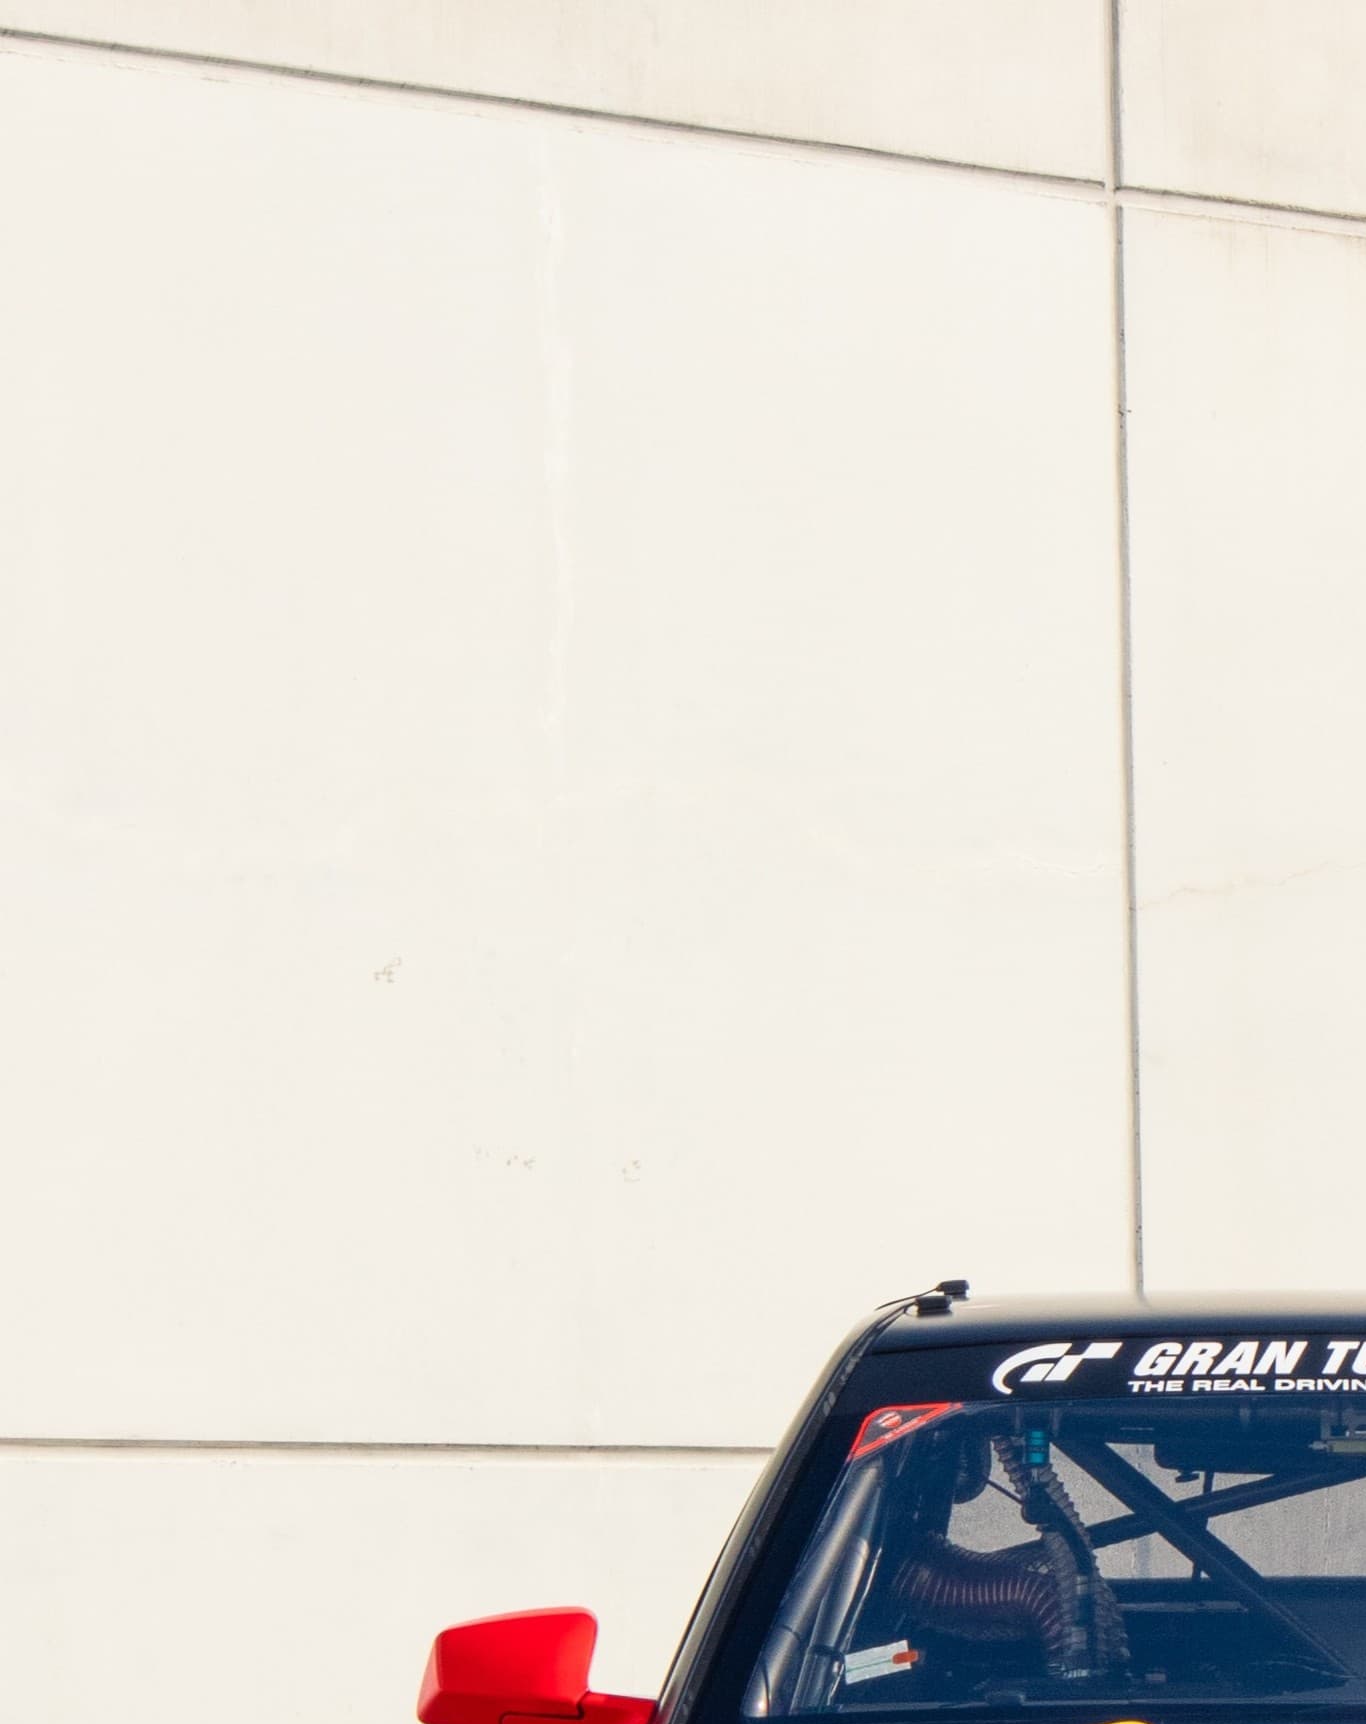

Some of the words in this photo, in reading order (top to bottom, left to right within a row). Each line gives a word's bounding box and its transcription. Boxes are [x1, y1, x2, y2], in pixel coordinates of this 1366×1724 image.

[1133, 1341, 1310, 1376] GRAN
[1128, 1380, 1183, 1393] THE
[1192, 1379, 1265, 1391] REAL
